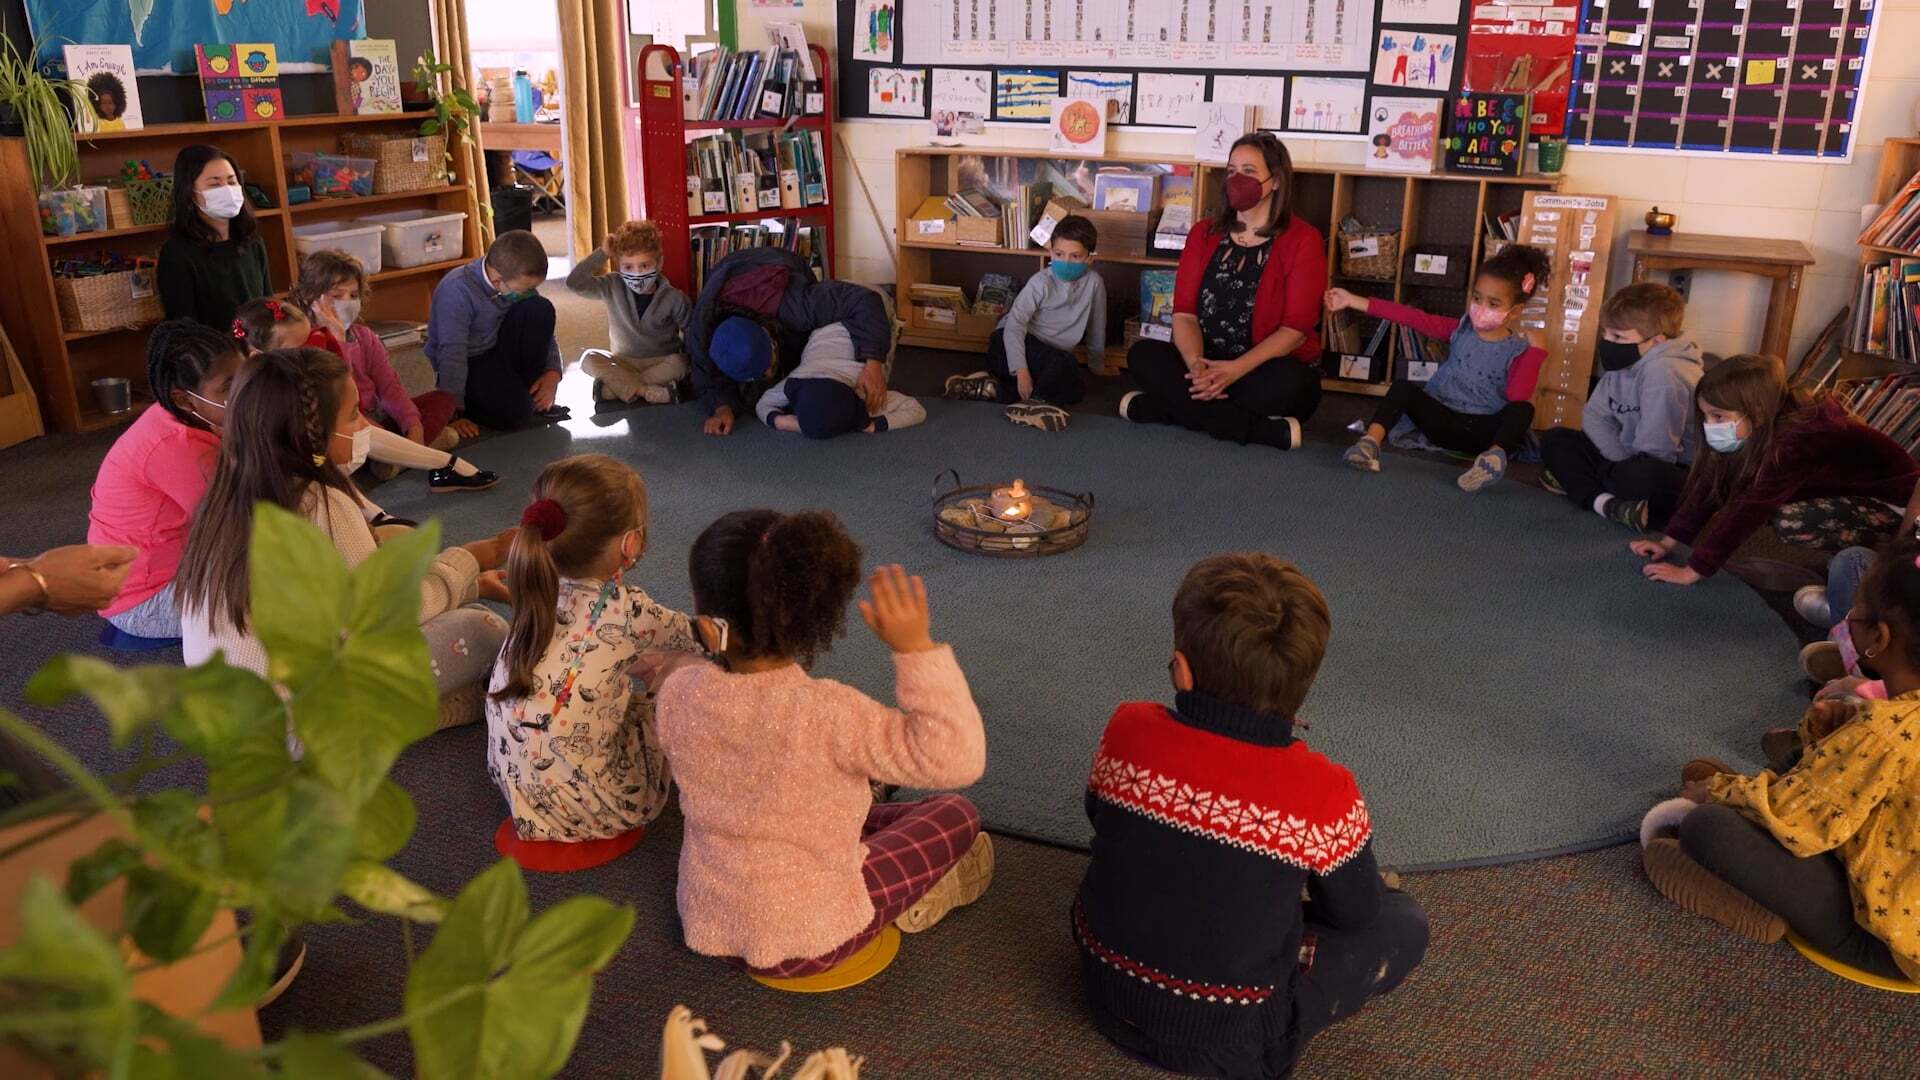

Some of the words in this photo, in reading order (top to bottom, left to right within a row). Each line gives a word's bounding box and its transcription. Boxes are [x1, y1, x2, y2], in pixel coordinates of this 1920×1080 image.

[375, 64, 391, 75] DAY
[376, 76, 394, 86] YOU
[1477, 100, 1498, 117] BE
[1456, 121, 1486, 134] WHO
[1489, 120, 1514, 136] YOU
[1398, 140, 1428, 151] BETTER
[1467, 136, 1496, 154] ARE
[1584, 199, 1605, 208] Jobs
